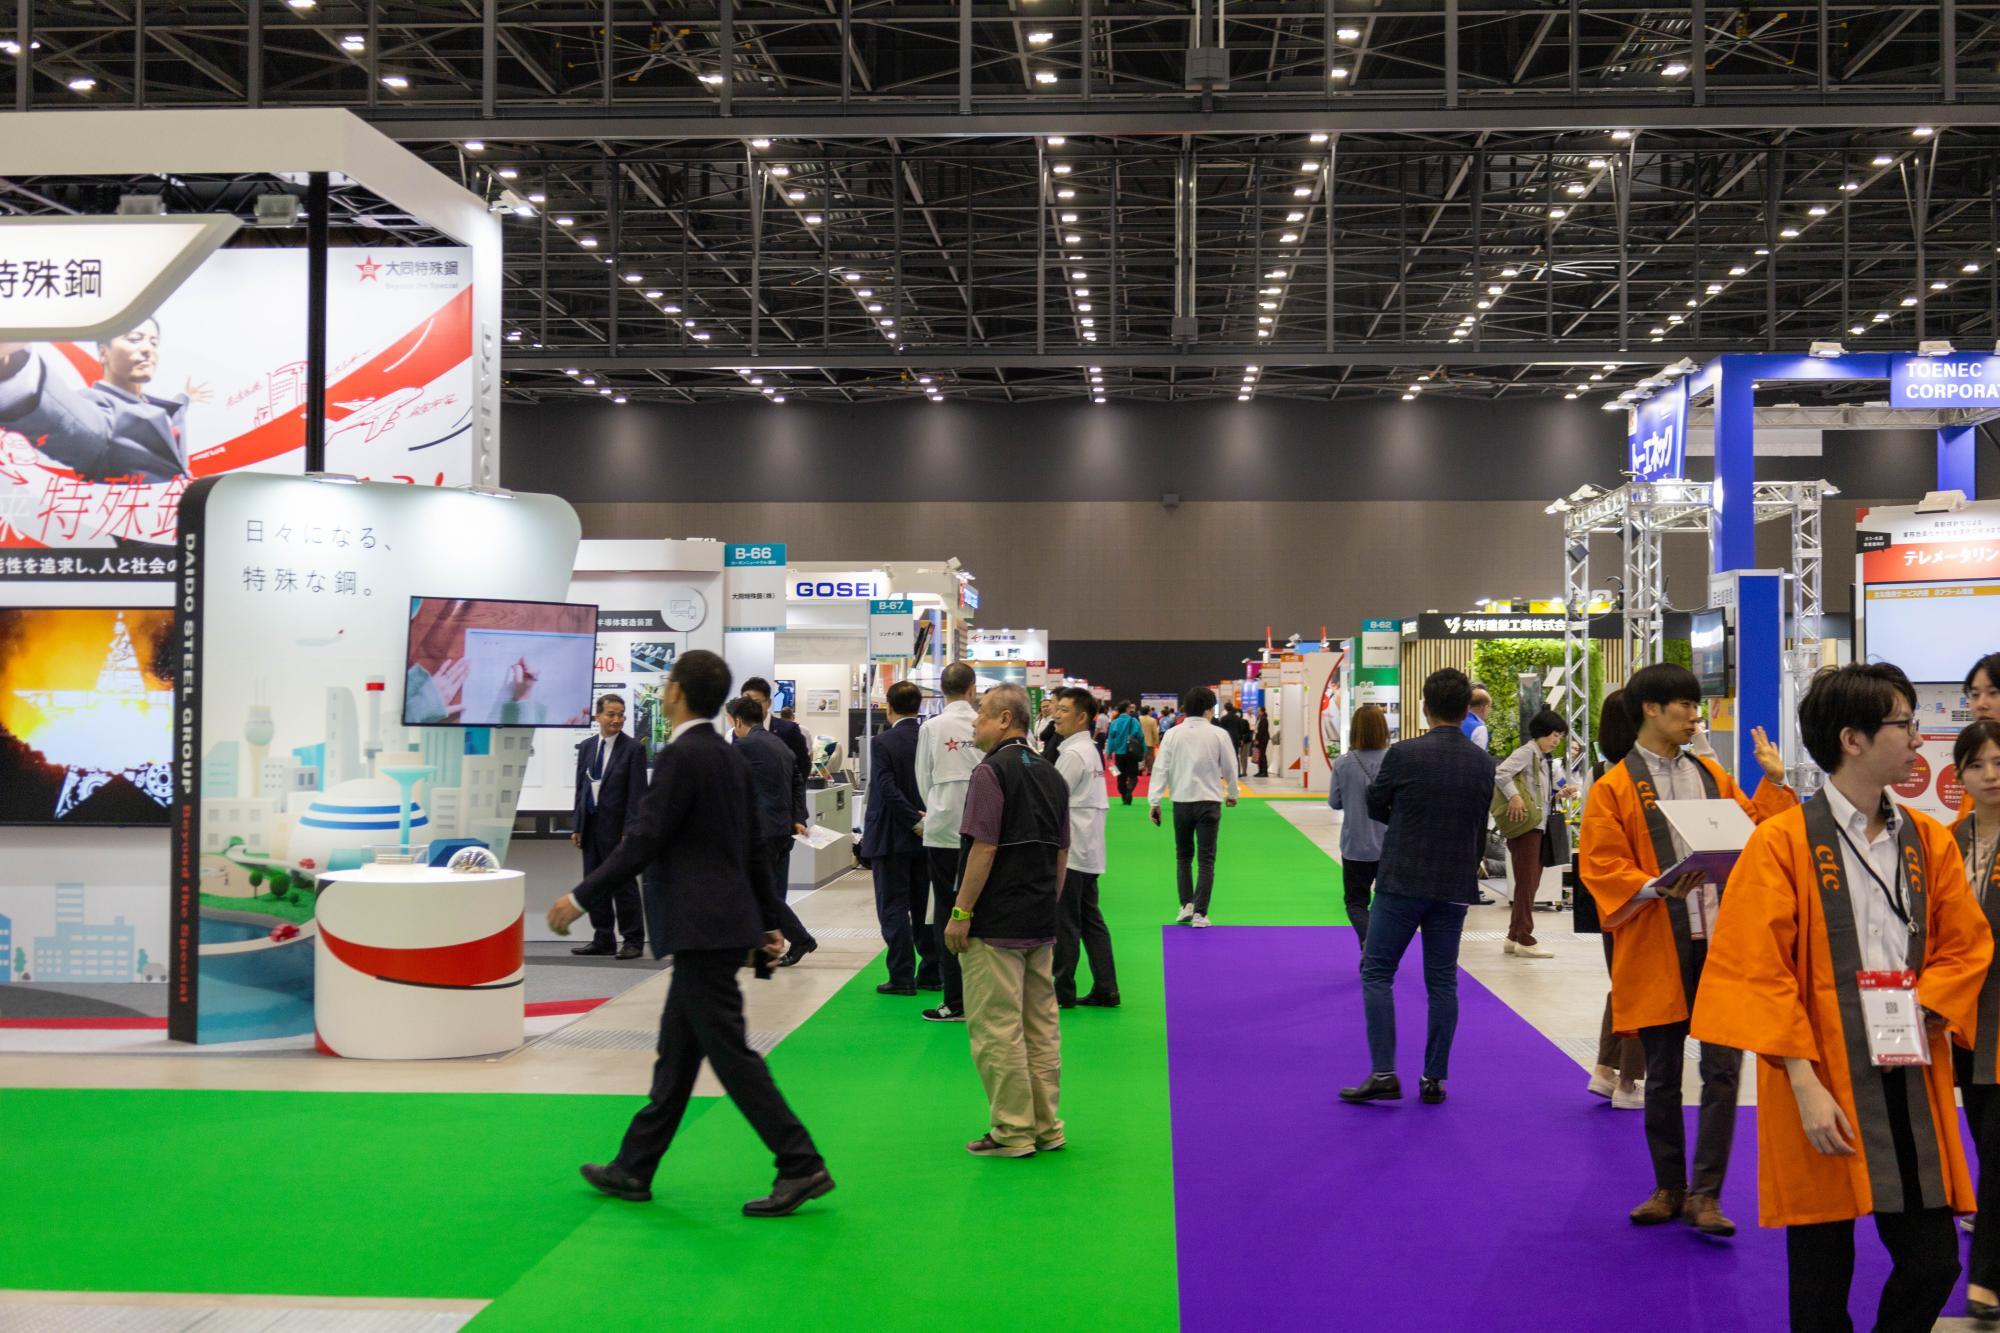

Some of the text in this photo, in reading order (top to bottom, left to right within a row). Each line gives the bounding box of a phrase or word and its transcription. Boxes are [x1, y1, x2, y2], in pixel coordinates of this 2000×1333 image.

[1906, 363, 1982, 378] TOENEC
[1906, 383, 2000, 399] CORPORA
[247, 520, 392, 551] 日々になる、
[735, 547, 772, 560] B-66
[243, 566, 372, 596] 特殊な鋼。
[796, 582, 877, 597] GOSEI
[879, 601, 904, 610] B-67
[181, 533, 196, 794] DAIDO STEEL GROUP
[1637, 780, 1658, 810] ctc
[1815, 844, 1841, 891] ctc
[1905, 845, 1922, 894] ctc
